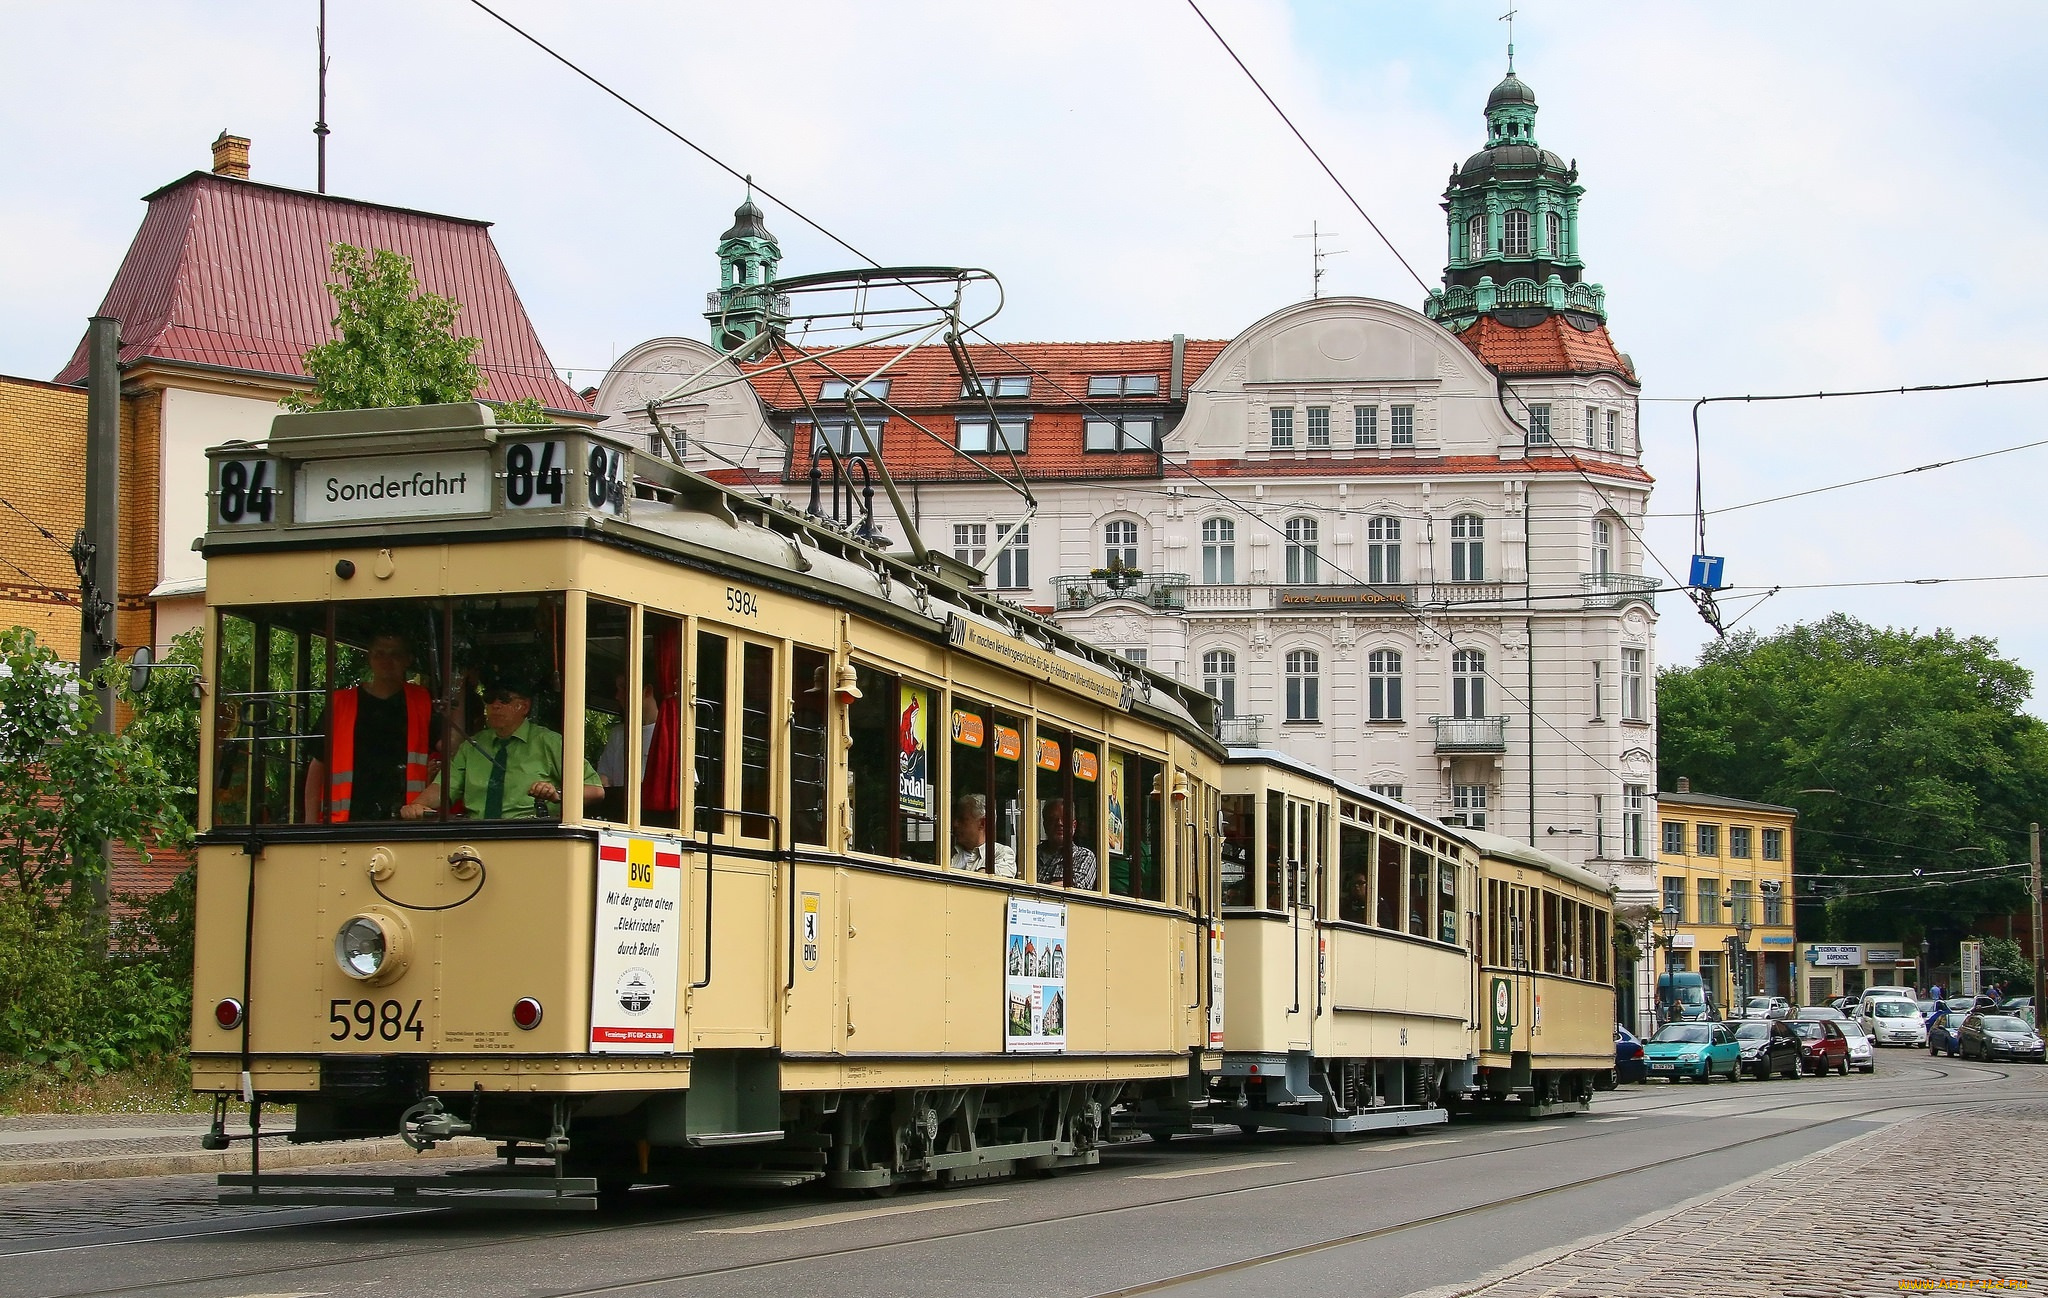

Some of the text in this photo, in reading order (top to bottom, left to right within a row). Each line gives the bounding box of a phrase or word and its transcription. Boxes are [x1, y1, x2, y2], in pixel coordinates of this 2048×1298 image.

[325, 471, 468, 502] Sonderfahrt
[506, 441, 564, 506] 84
[220, 461, 272, 522] 84
[1698, 558, 1718, 584] T
[726, 586, 758, 618] 5984
[976, 634, 995, 650] machen
[631, 863, 651, 883] BVG
[606, 891, 674, 911] Mit der guten alten
[617, 942, 660, 957] durch Berlin
[804, 944, 816, 961] BVG
[330, 1000, 424, 1042] 5984
